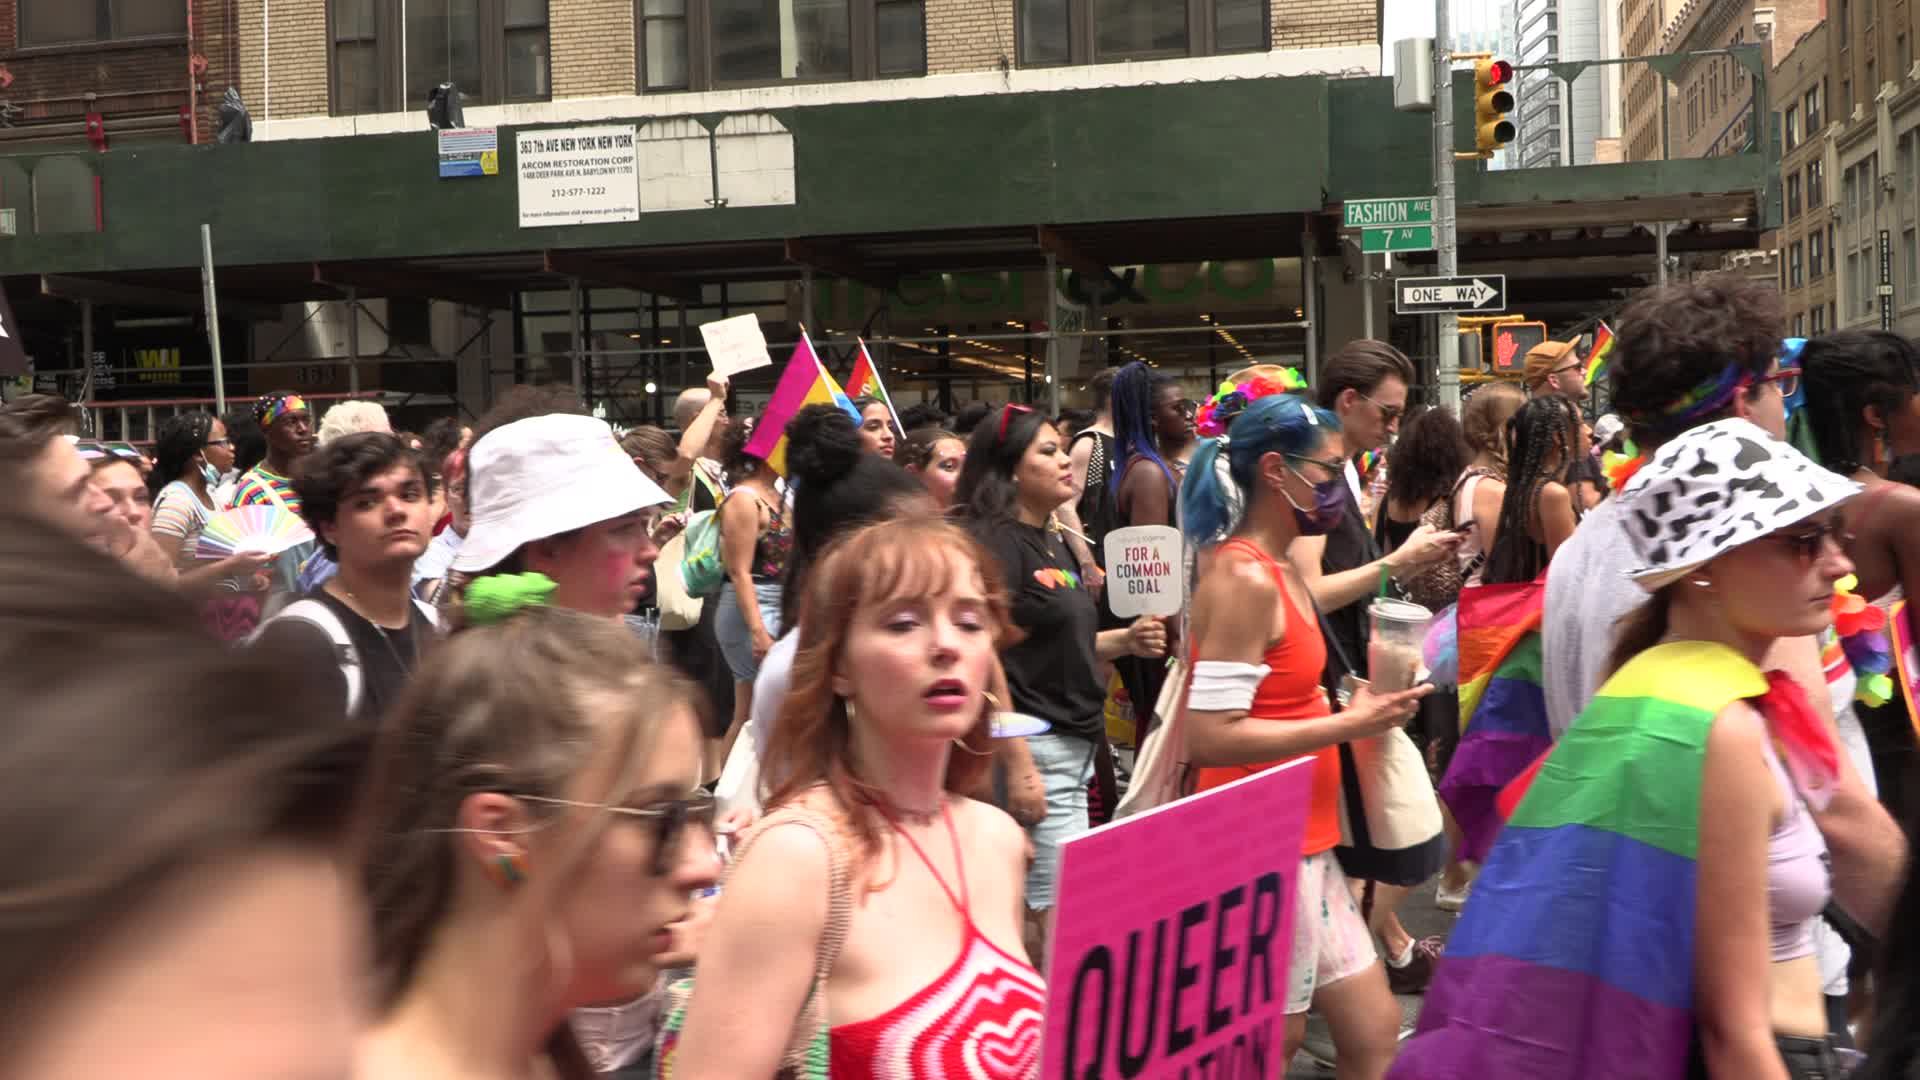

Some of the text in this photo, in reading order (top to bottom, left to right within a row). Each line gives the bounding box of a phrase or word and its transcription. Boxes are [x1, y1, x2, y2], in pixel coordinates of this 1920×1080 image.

[520, 134, 633, 154] 363 7th AVE NEW YORK NEW YORK
[521, 156, 633, 169] ARCOM RESTORATION CORP
[550, 169, 564, 178] PARK
[565, 168, 575, 177] AVE
[582, 167, 608, 176] BABYLON
[551, 187, 606, 197] 212-577-1222
[1347, 200, 1430, 225] FASHION AVE
[1383, 228, 1413, 249] 7 AV
[1411, 286, 1487, 302] ONE WAY
[1125, 546, 1160, 562] FOR A
[1116, 561, 1171, 578] COMMON
[1128, 579, 1160, 594] GOAL
[1063, 872, 1283, 1080] QUEER
